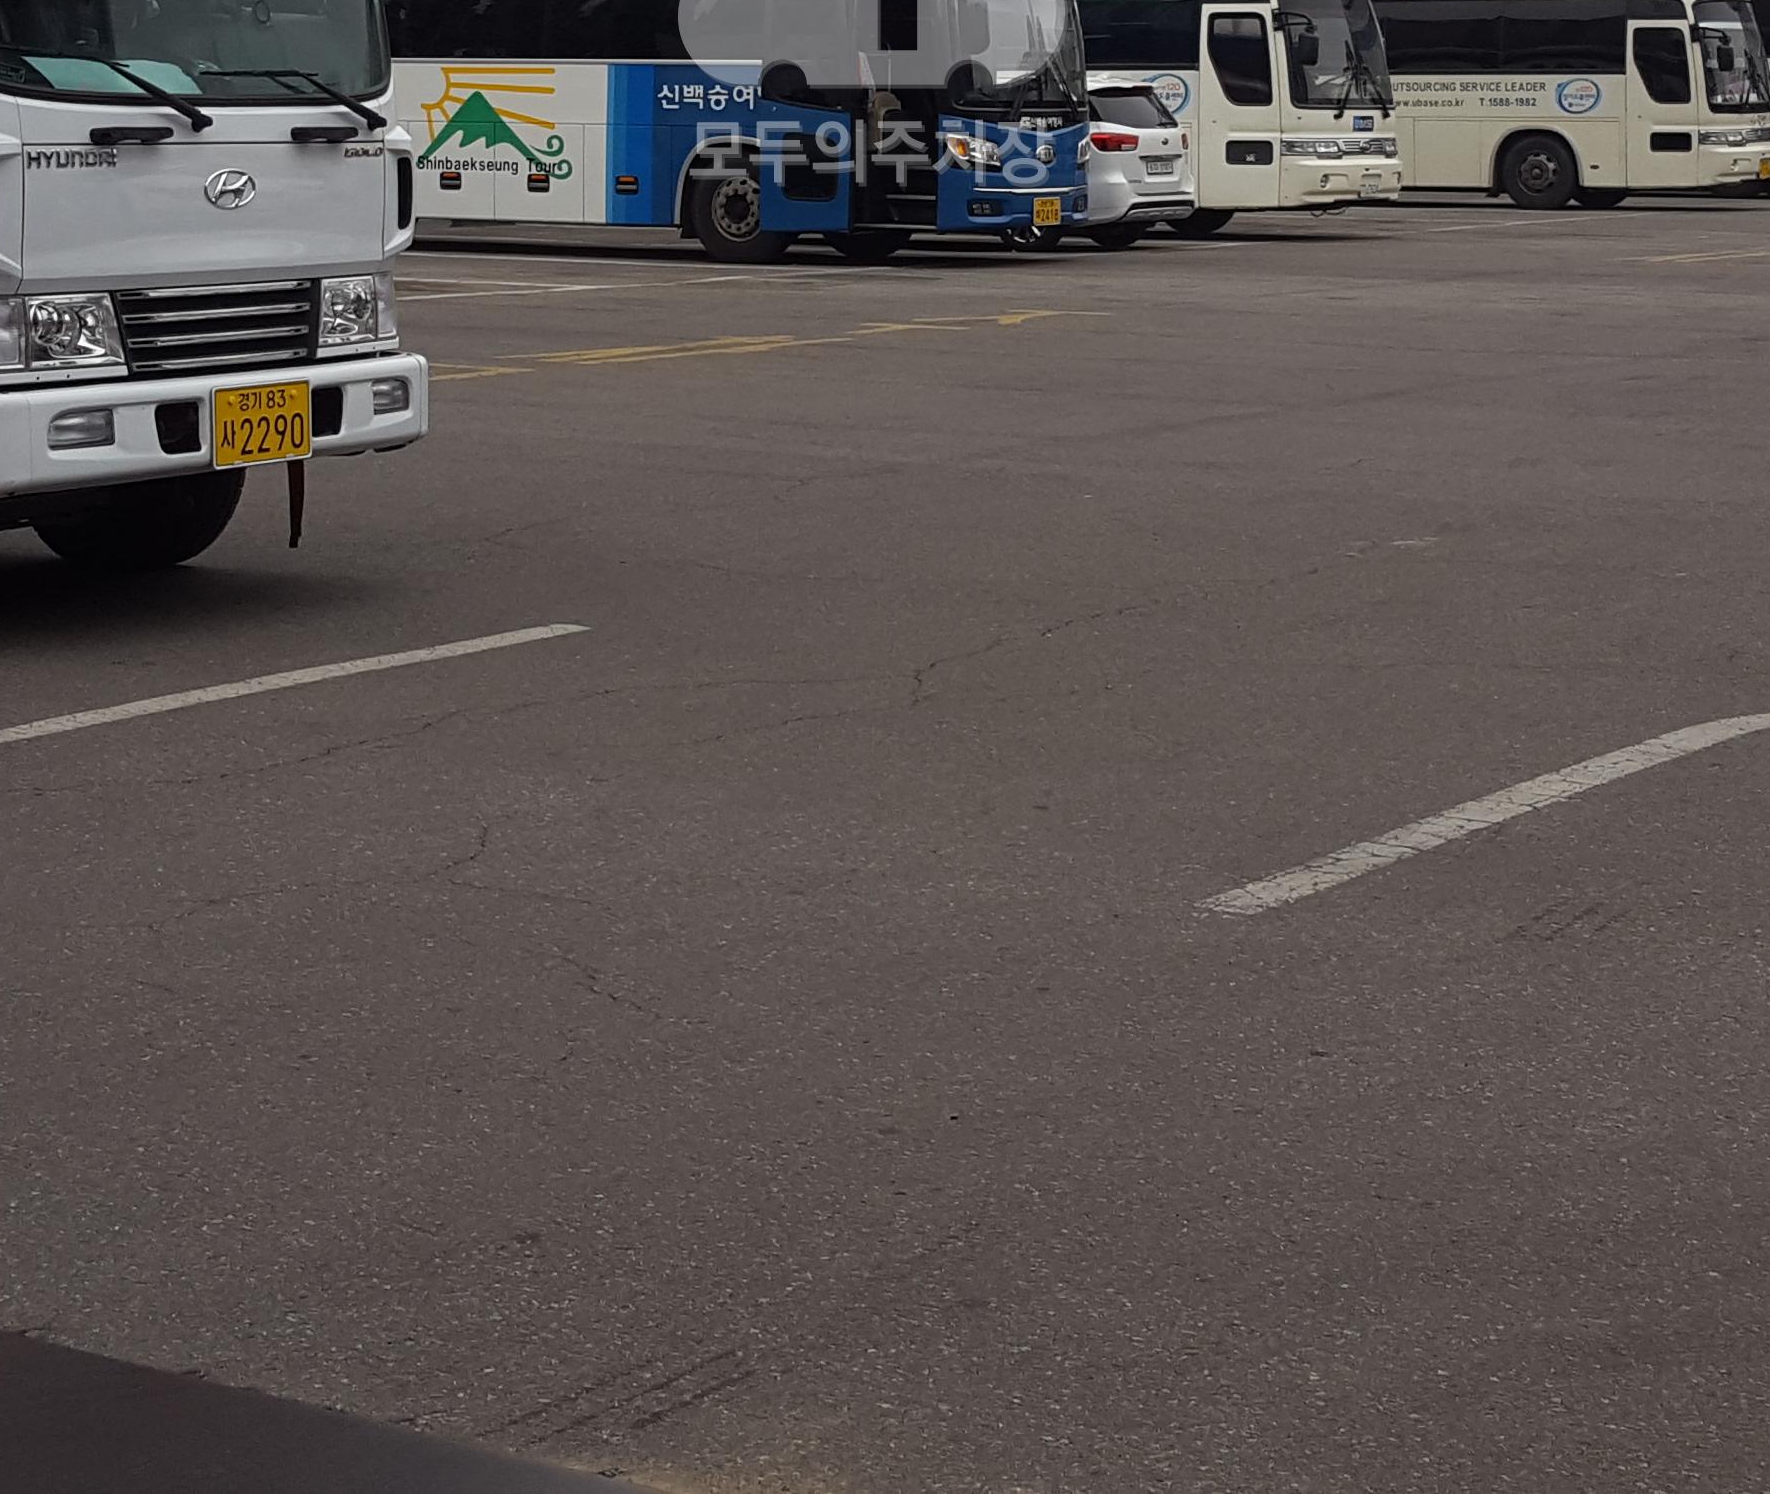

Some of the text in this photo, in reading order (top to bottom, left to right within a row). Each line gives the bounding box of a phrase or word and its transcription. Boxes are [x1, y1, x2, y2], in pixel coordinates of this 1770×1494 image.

[1391, 81, 1547, 93] UTSOURCING SERVICE LEADER
[26, 147, 118, 169] HYUNDAI
[416, 155, 558, 175] Shinbaekseung Tour
[237, 390, 287, 412] 경기 83
